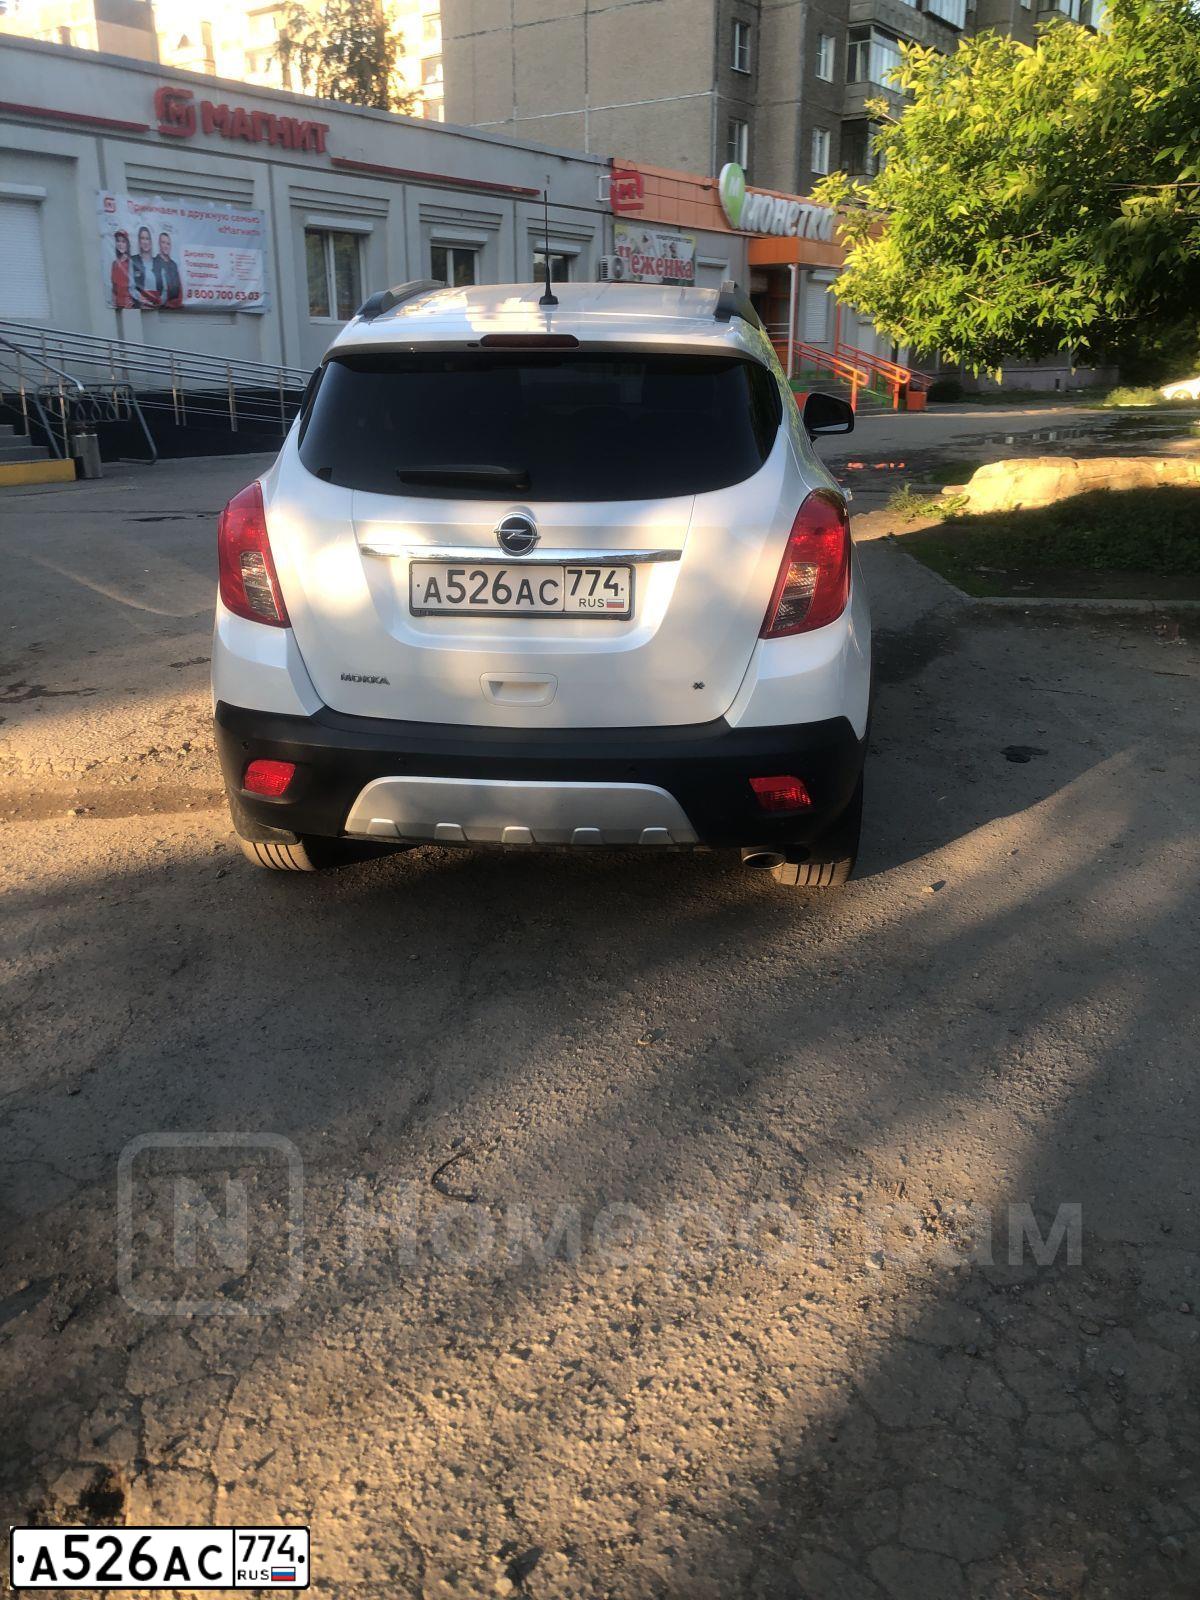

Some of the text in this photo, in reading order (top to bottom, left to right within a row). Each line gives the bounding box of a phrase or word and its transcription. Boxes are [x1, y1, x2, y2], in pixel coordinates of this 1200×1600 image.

[201, 100, 330, 153] МАГНИТ
[194, 289, 214, 299] 800
[215, 290, 233, 300] 700
[423, 569, 619, 606] А526АС 774
[579, 598, 605, 608] RUS
[341, 673, 391, 686] MOKKA
